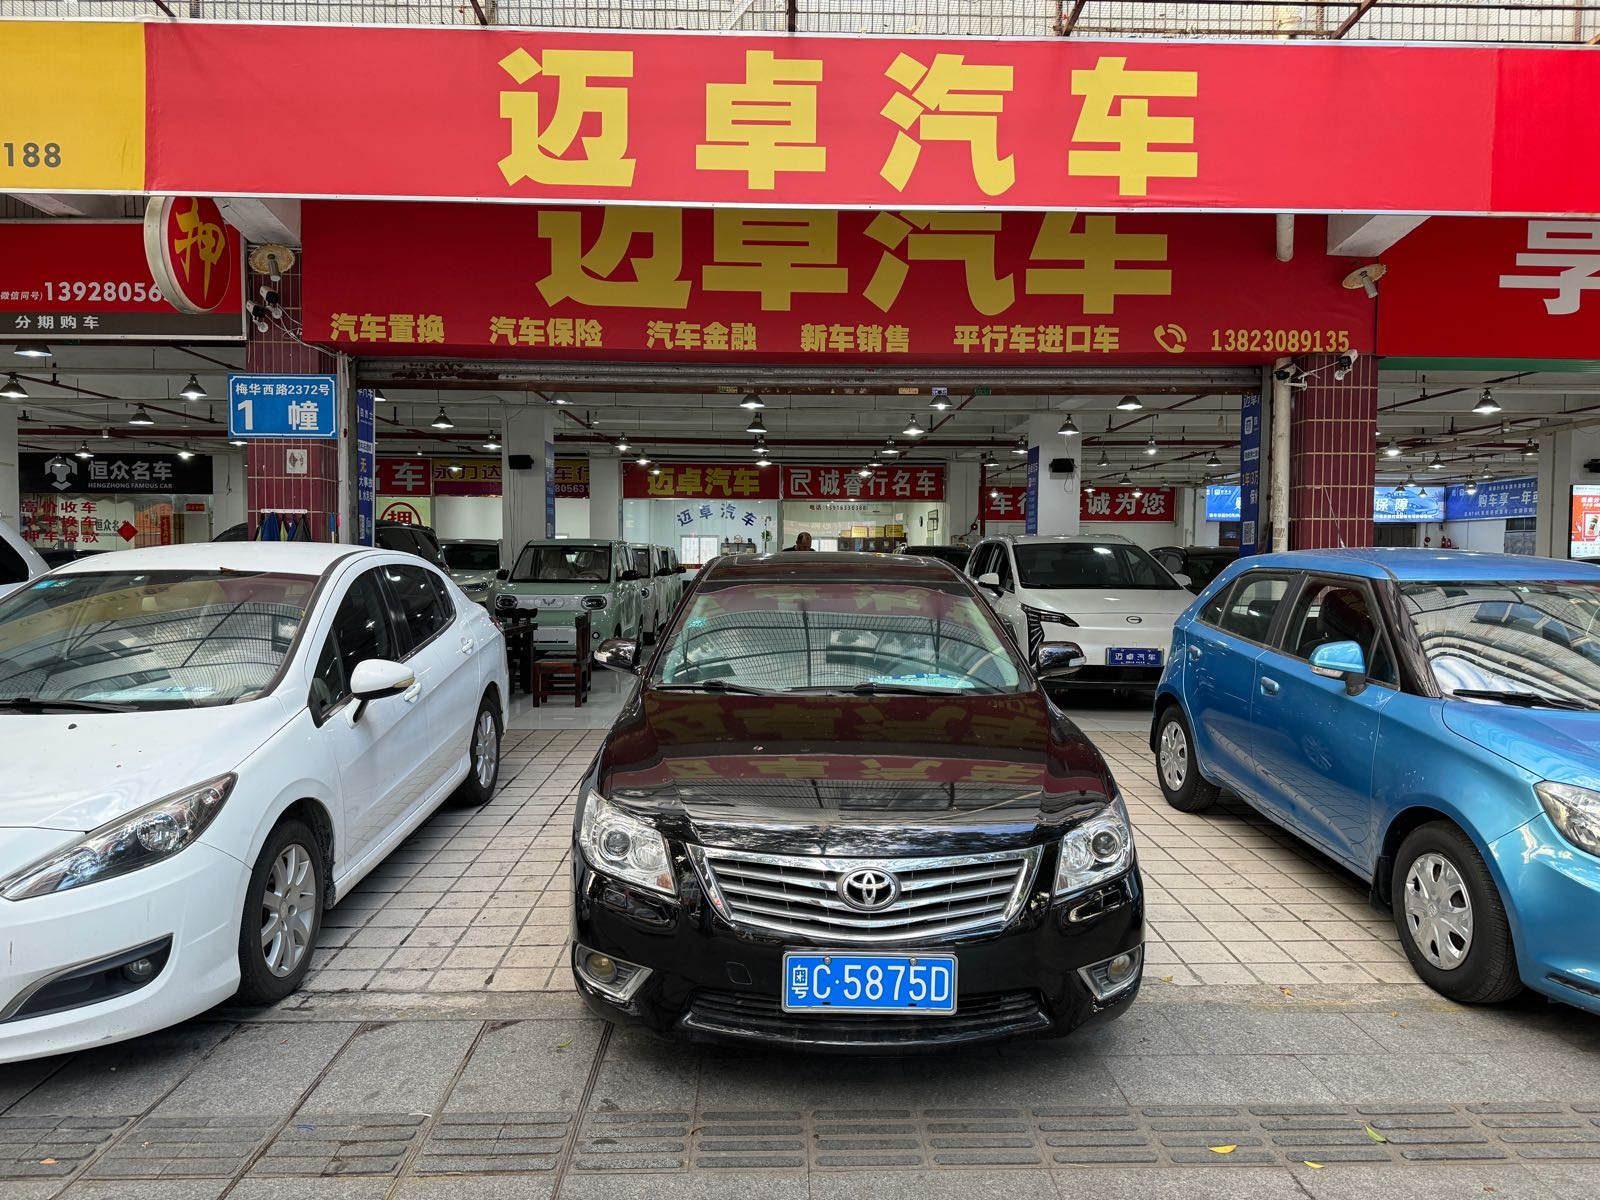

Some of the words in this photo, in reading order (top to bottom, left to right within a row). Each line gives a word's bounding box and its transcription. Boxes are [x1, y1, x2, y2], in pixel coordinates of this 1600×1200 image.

[497, 47, 1199, 197] 迈卓汽车
[3, 142, 62, 168] 188
[535, 208, 1173, 316] 迈卓汽车
[44, 281, 168, 302] 13928056
[15, 315, 100, 329] 分期购车
[330, 313, 445, 343] 汽车置换
[489, 316, 602, 347] 汽车保险
[646, 320, 757, 351] 汽车金融
[800, 323, 910, 353] 新车销售
[953, 324, 1120, 353] 平行车进口车
[1211, 327, 1349, 353] 13823089135
[235, 383, 331, 396] 梅华西路2372号
[237, 400, 253, 430] 1
[288, 400, 319, 431] 幢
[88, 461, 173, 480] 恒众名车
[647, 467, 760, 496] 迈卓汽车
[818, 469, 936, 497] 诚睿行名车
[21, 501, 97, 514] 高价收车
[677, 503, 757, 527] 迈卓汽车
[22, 530, 99, 543] 押车贷款
